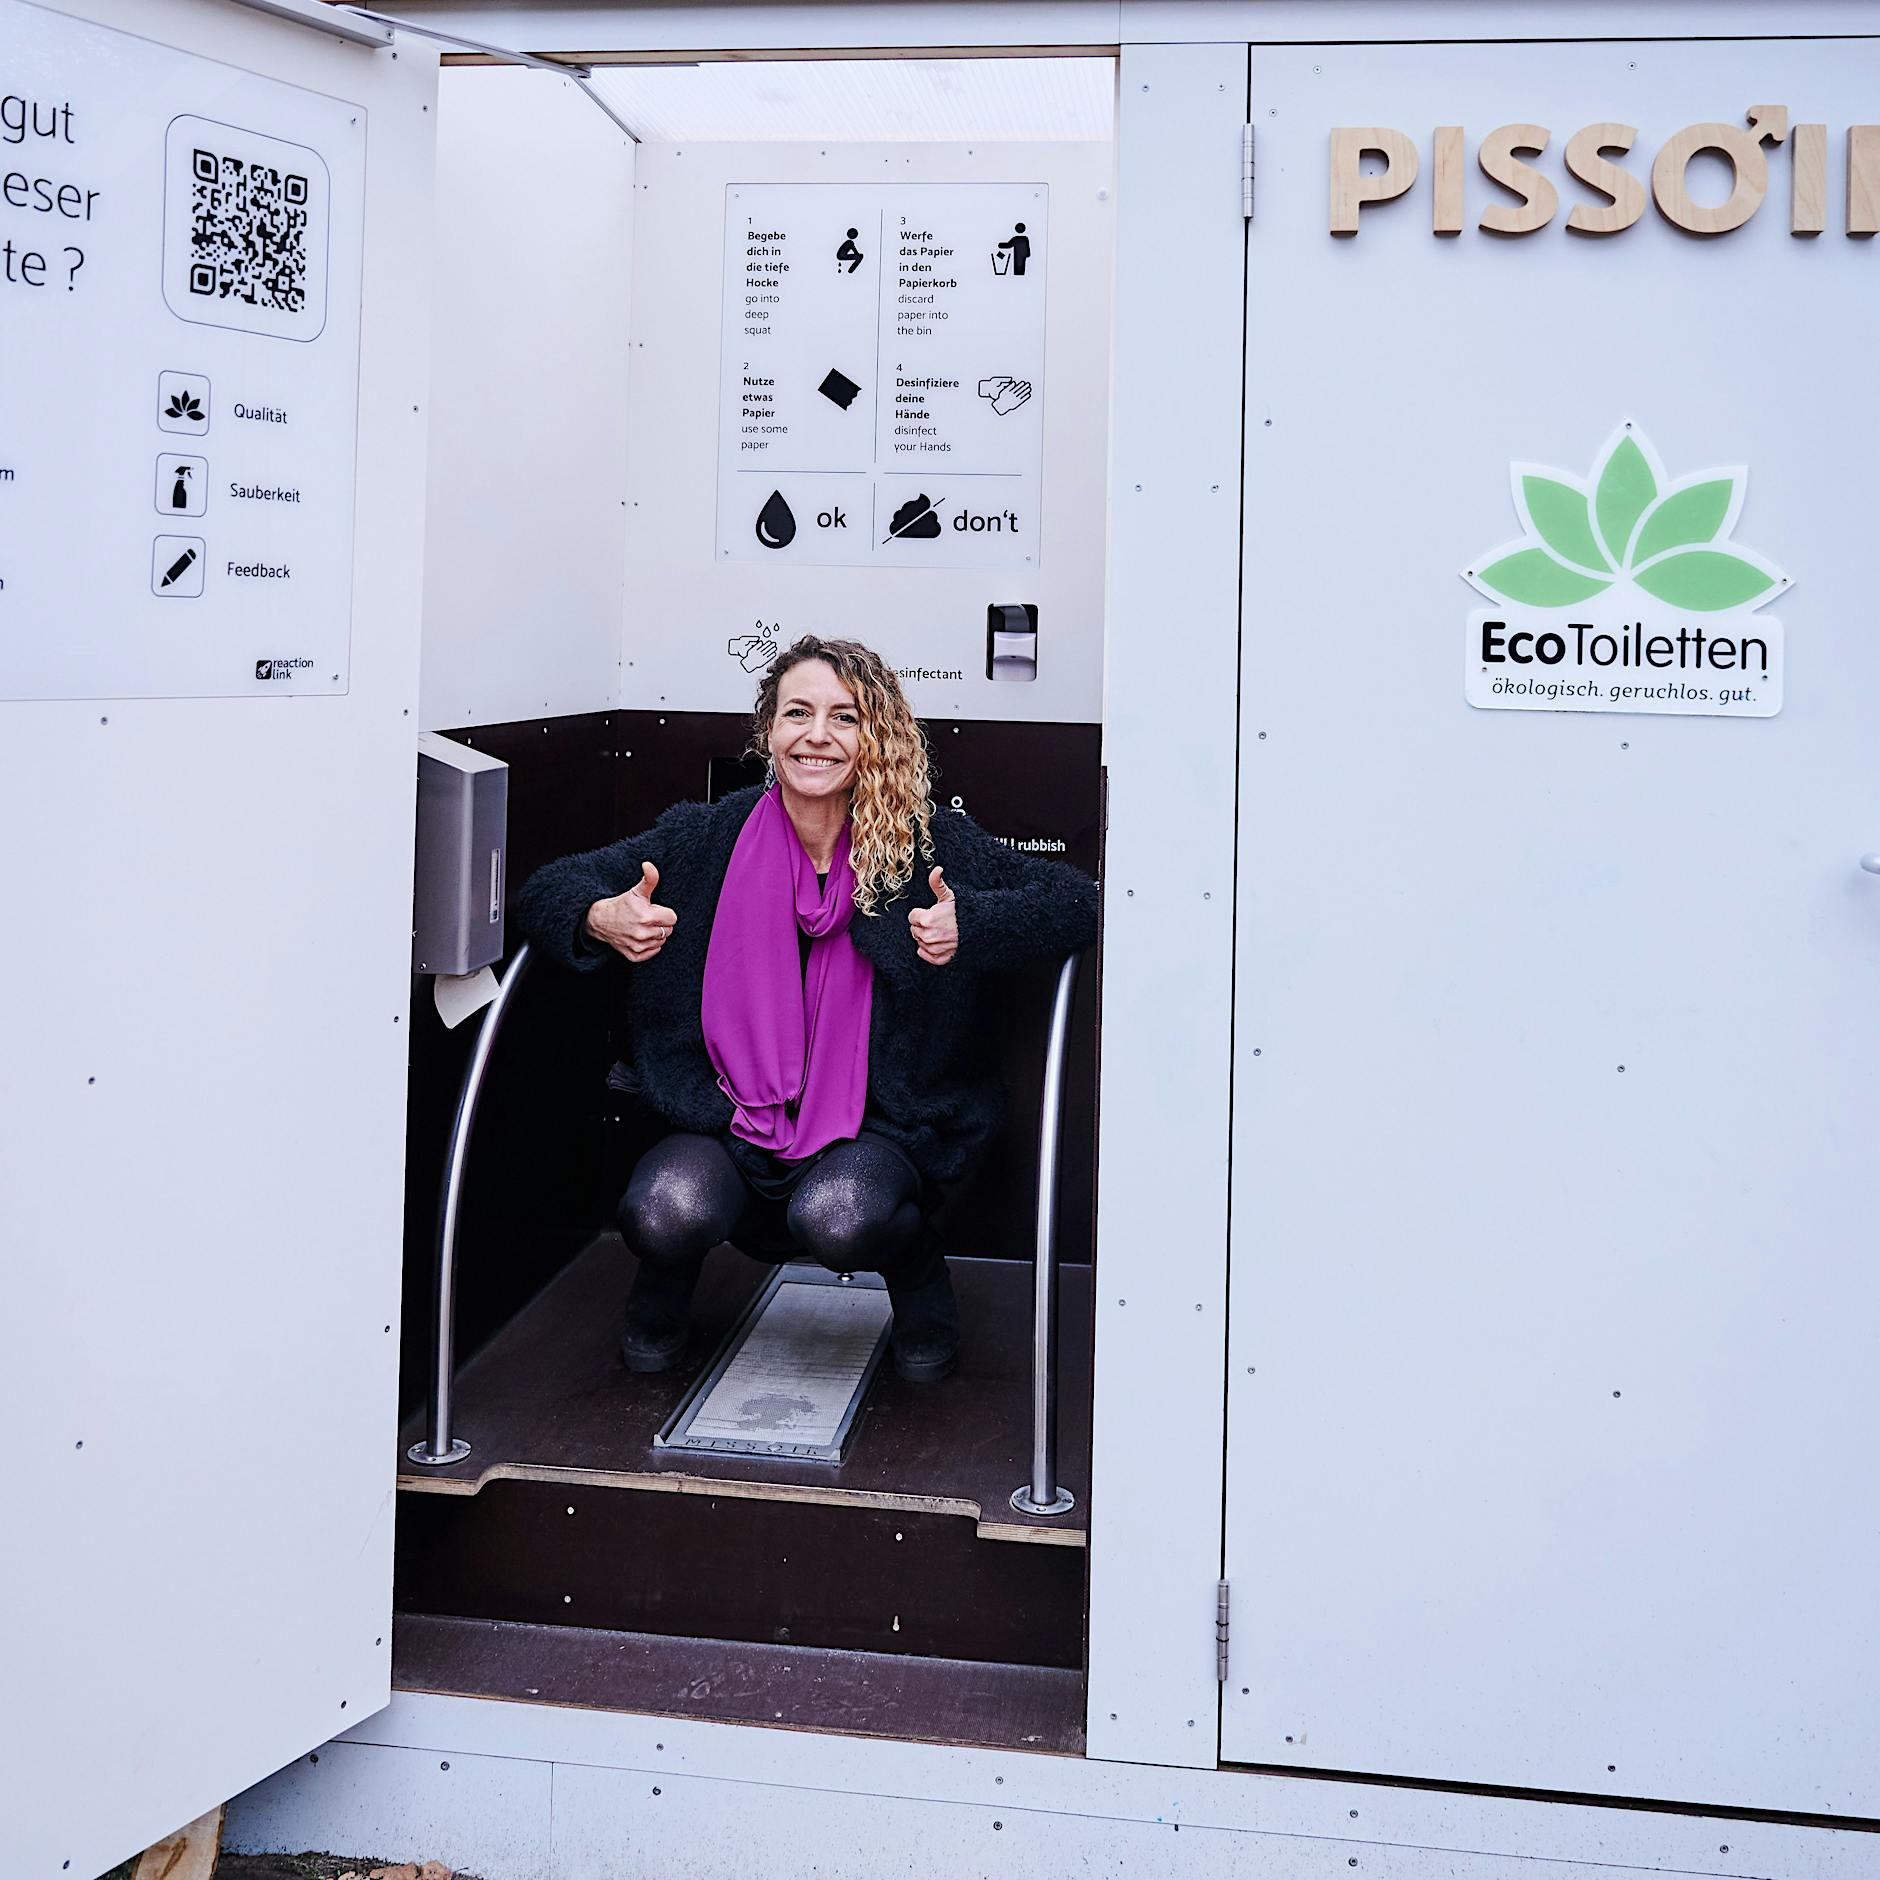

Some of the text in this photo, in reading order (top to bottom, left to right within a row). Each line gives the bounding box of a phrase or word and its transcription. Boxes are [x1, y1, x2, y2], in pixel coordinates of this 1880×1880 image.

[0, 96, 76, 145] gut
[747, 230, 787, 243] Begebe
[899, 230, 934, 244] Werfe
[746, 245, 782, 257] dich in
[899, 246, 955, 259] das Papier
[745, 261, 790, 275] die tiefe
[898, 261, 932, 273] in den
[746, 277, 779, 288] Hocke
[898, 277, 958, 291] Papierkorb
[744, 293, 780, 306] go into
[897, 293, 934, 304] discard
[744, 309, 770, 321] deep
[897, 309, 949, 323] paper into
[744, 326, 772, 337] squat
[896, 325, 932, 336] the bin
[743, 376, 775, 387] Nutze
[896, 377, 960, 391] Desinfiziere
[742, 393, 774, 402] etwas
[895, 393, 925, 404] deine
[233, 404, 288, 425] Qualität
[742, 407, 776, 421] Papier
[895, 408, 930, 420] Hände
[741, 425, 789, 434] use some
[894, 425, 937, 438] disinfect
[741, 441, 769, 452] paper
[893, 440, 952, 454] your Hands
[230, 483, 301, 504] Sauberkeit
[816, 506, 848, 529] ok
[227, 562, 291, 579] Feedback
[1482, 622, 1768, 672] EcoToiletten
[272, 656, 314, 671] reaction
[271, 668, 292, 681] link
[1491, 678, 1757, 706] ökologisch. geruchlos. gut.
[1017, 838, 1066, 852] rubbish
